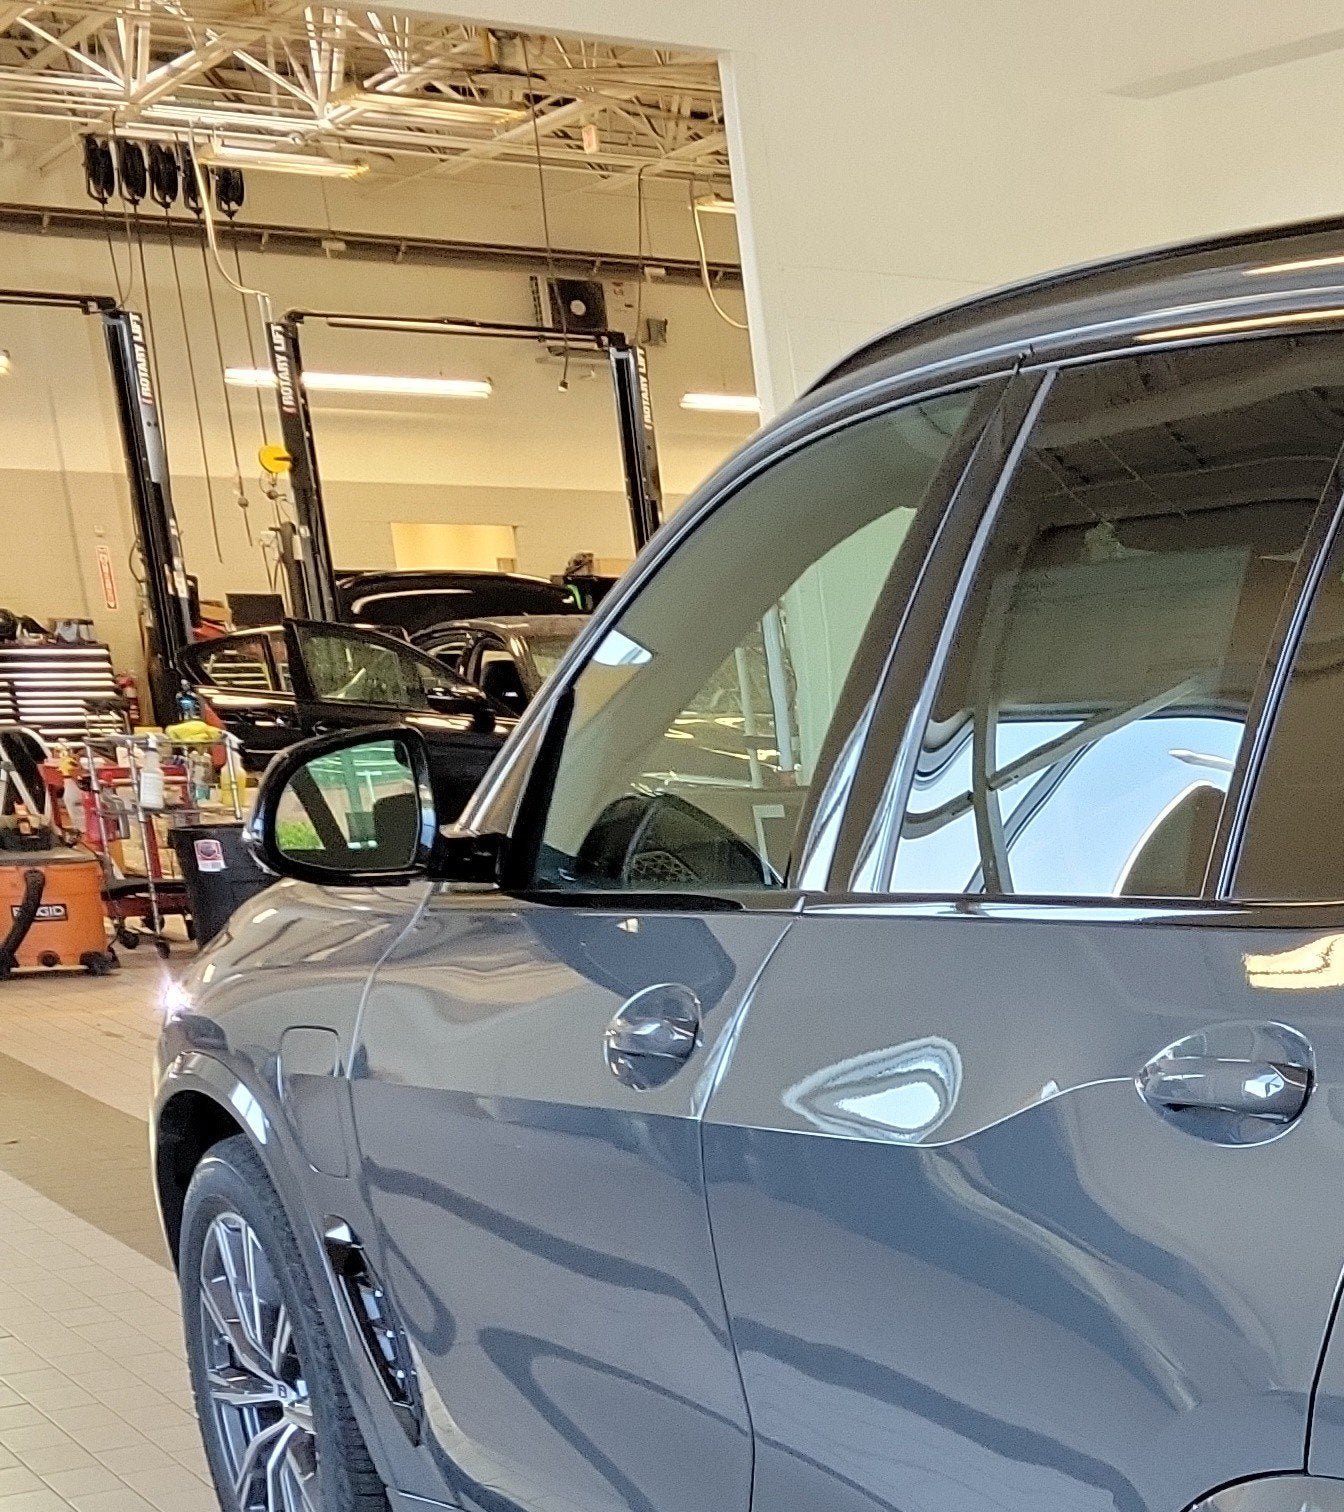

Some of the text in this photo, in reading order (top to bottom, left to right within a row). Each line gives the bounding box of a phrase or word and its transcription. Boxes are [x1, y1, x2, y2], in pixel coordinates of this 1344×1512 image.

[129, 313, 153, 398] ROTARY LIFT
[270, 323, 296, 407] ROTARY LIFT
[12, 905, 66, 917] RGID
